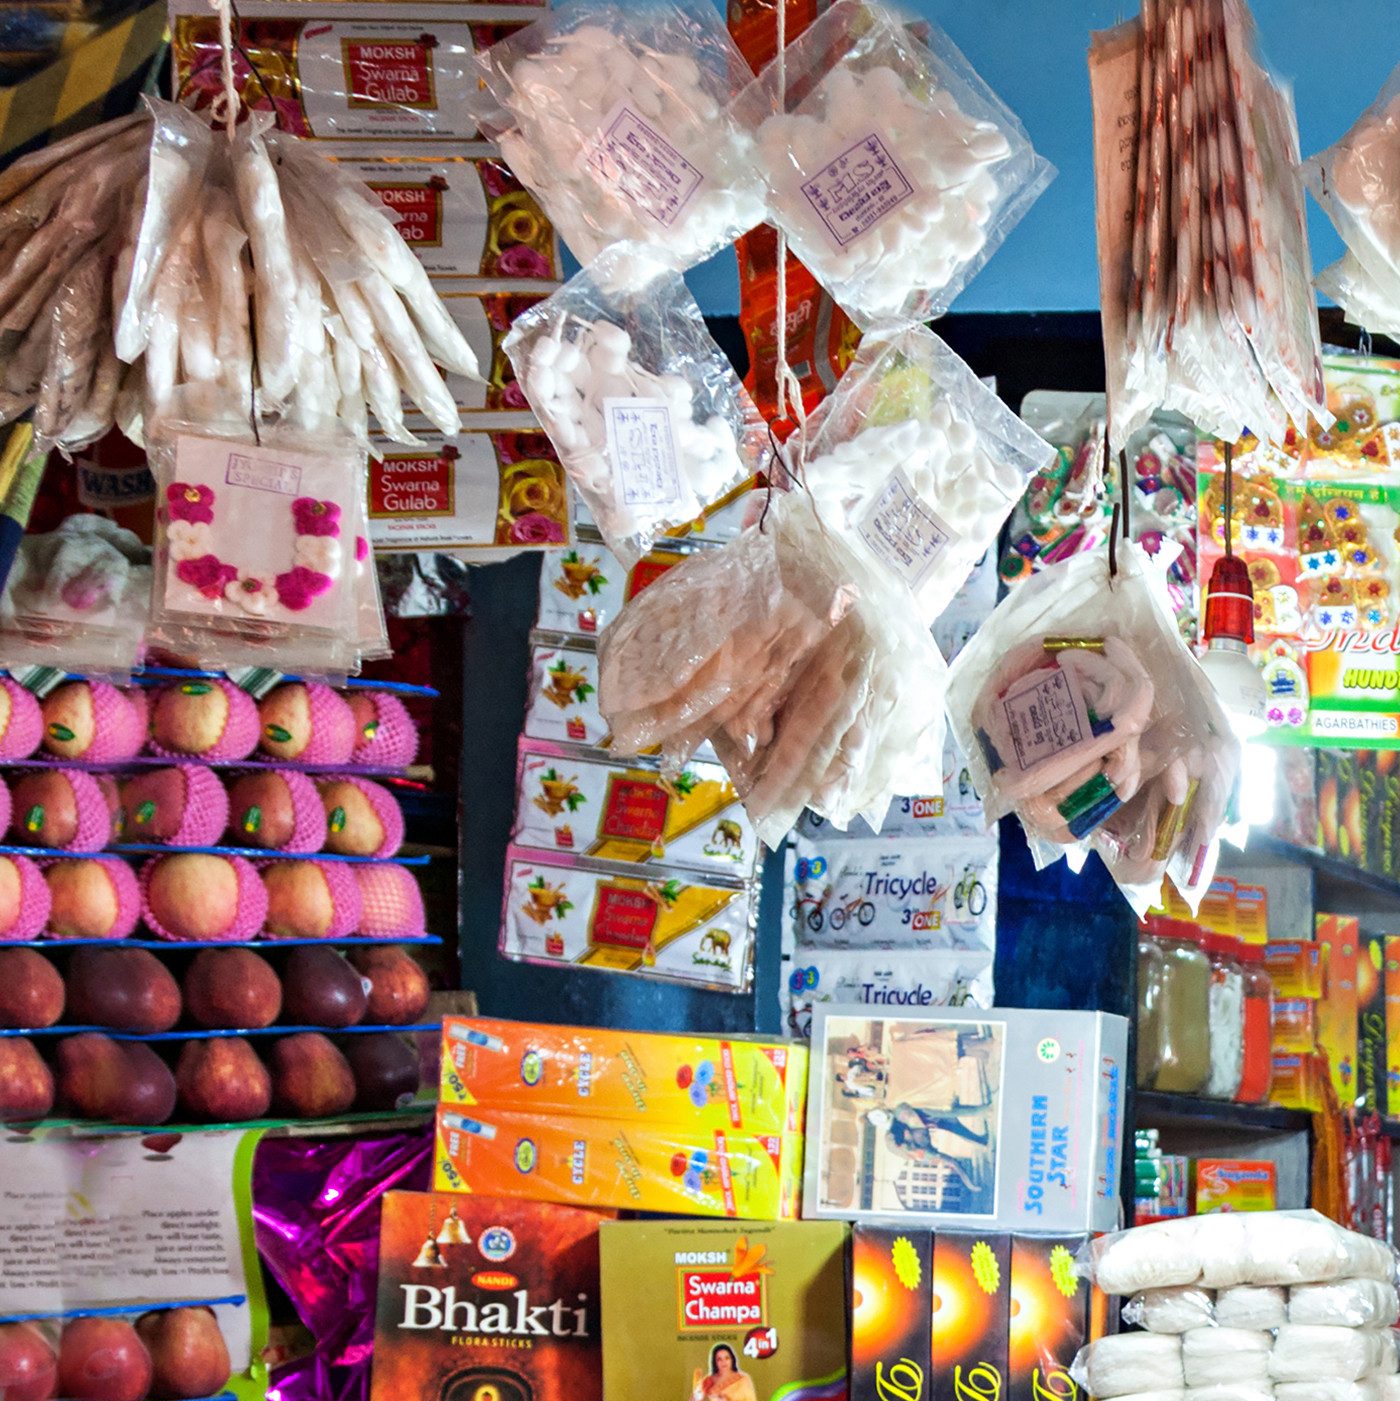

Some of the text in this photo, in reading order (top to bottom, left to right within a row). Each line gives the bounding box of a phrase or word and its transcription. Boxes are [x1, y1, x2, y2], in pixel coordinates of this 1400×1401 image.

[360, 47, 416, 60] MOKSH
[360, 63, 420, 82] Swarna
[365, 83, 419, 102] Gulab
[383, 461, 438, 472] MOKSH
[381, 475, 440, 492] Swarna
[384, 494, 437, 511] Gulab
[1315, 717, 1397, 732] AGARBATHIES
[914, 802, 943, 816] ONE
[866, 871, 937, 899] Tricycle
[913, 914, 941, 929] ONE
[862, 983, 932, 1006] Tricycle
[578, 1052, 593, 1097] CYCLE
[572, 1139, 587, 1186] CYCLE
[1024, 1095, 1048, 1215] SOUTHERN
[1047, 1125, 1069, 1186] STAR
[675, 1252, 727, 1264] MOKSH
[688, 1275, 755, 1295] Swarna
[397, 1284, 589, 1337] Bhakti
[686, 1298, 760, 1323] Champa
[451, 1336, 533, 1349] FLORA STICKS
